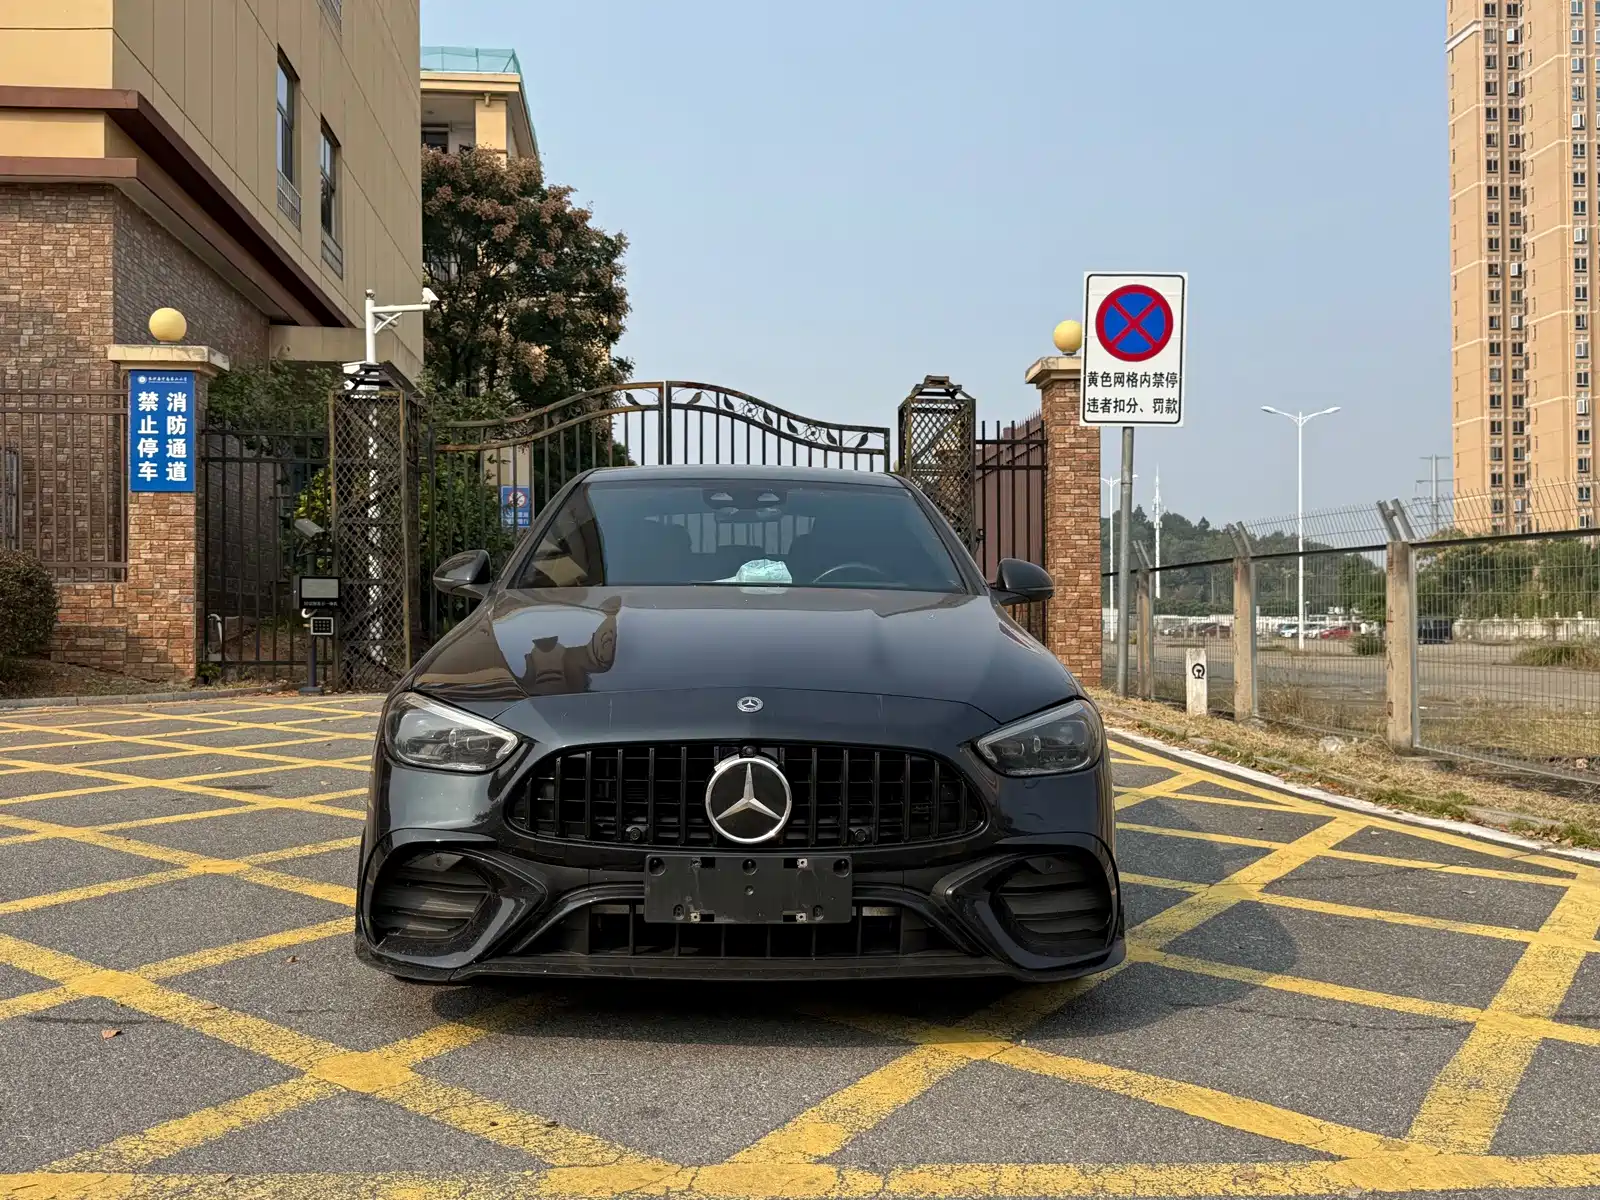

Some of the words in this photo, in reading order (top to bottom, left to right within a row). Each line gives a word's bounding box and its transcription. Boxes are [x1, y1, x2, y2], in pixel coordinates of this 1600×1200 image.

[1086, 397, 1178, 414] 违者扣分、罚款
[1087, 371, 1178, 388] 黄色网格内禁停
[137, 391, 159, 482] 禁止停车
[165, 391, 187, 482] 消防通道
